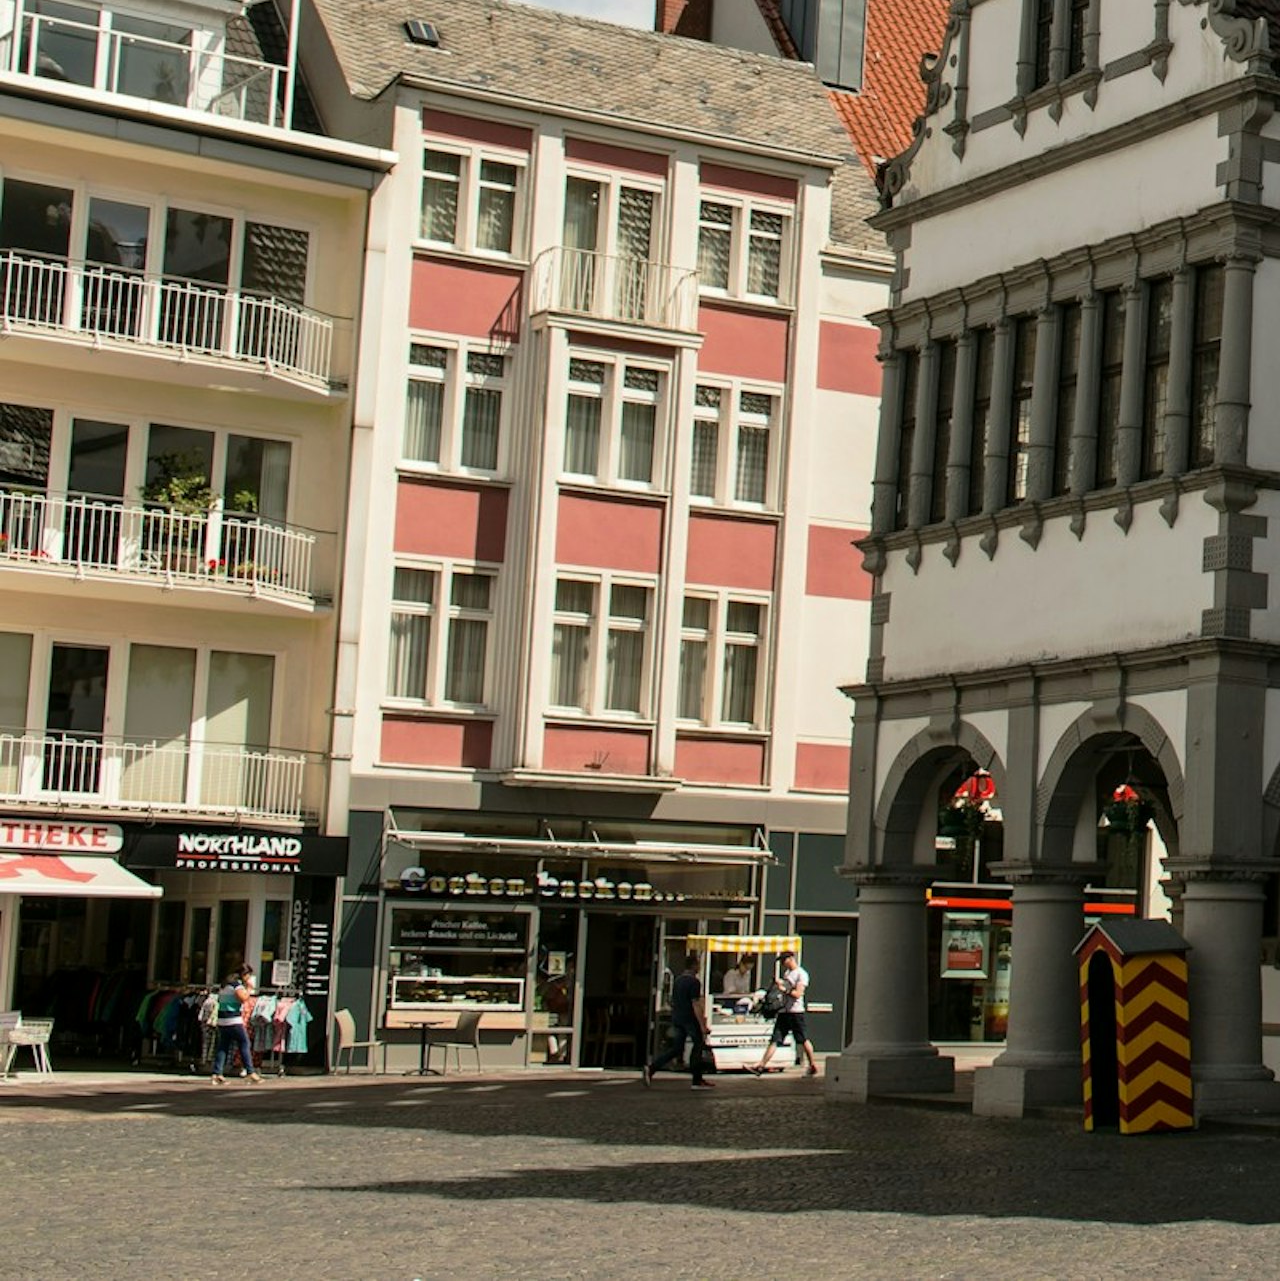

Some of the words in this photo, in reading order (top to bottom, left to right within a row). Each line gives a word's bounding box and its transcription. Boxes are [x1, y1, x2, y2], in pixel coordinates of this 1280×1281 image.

[1, 822, 109, 847] THEKE
[178, 833, 302, 856] NORTHLAND
[176, 860, 301, 872] PROFESSIONAL
